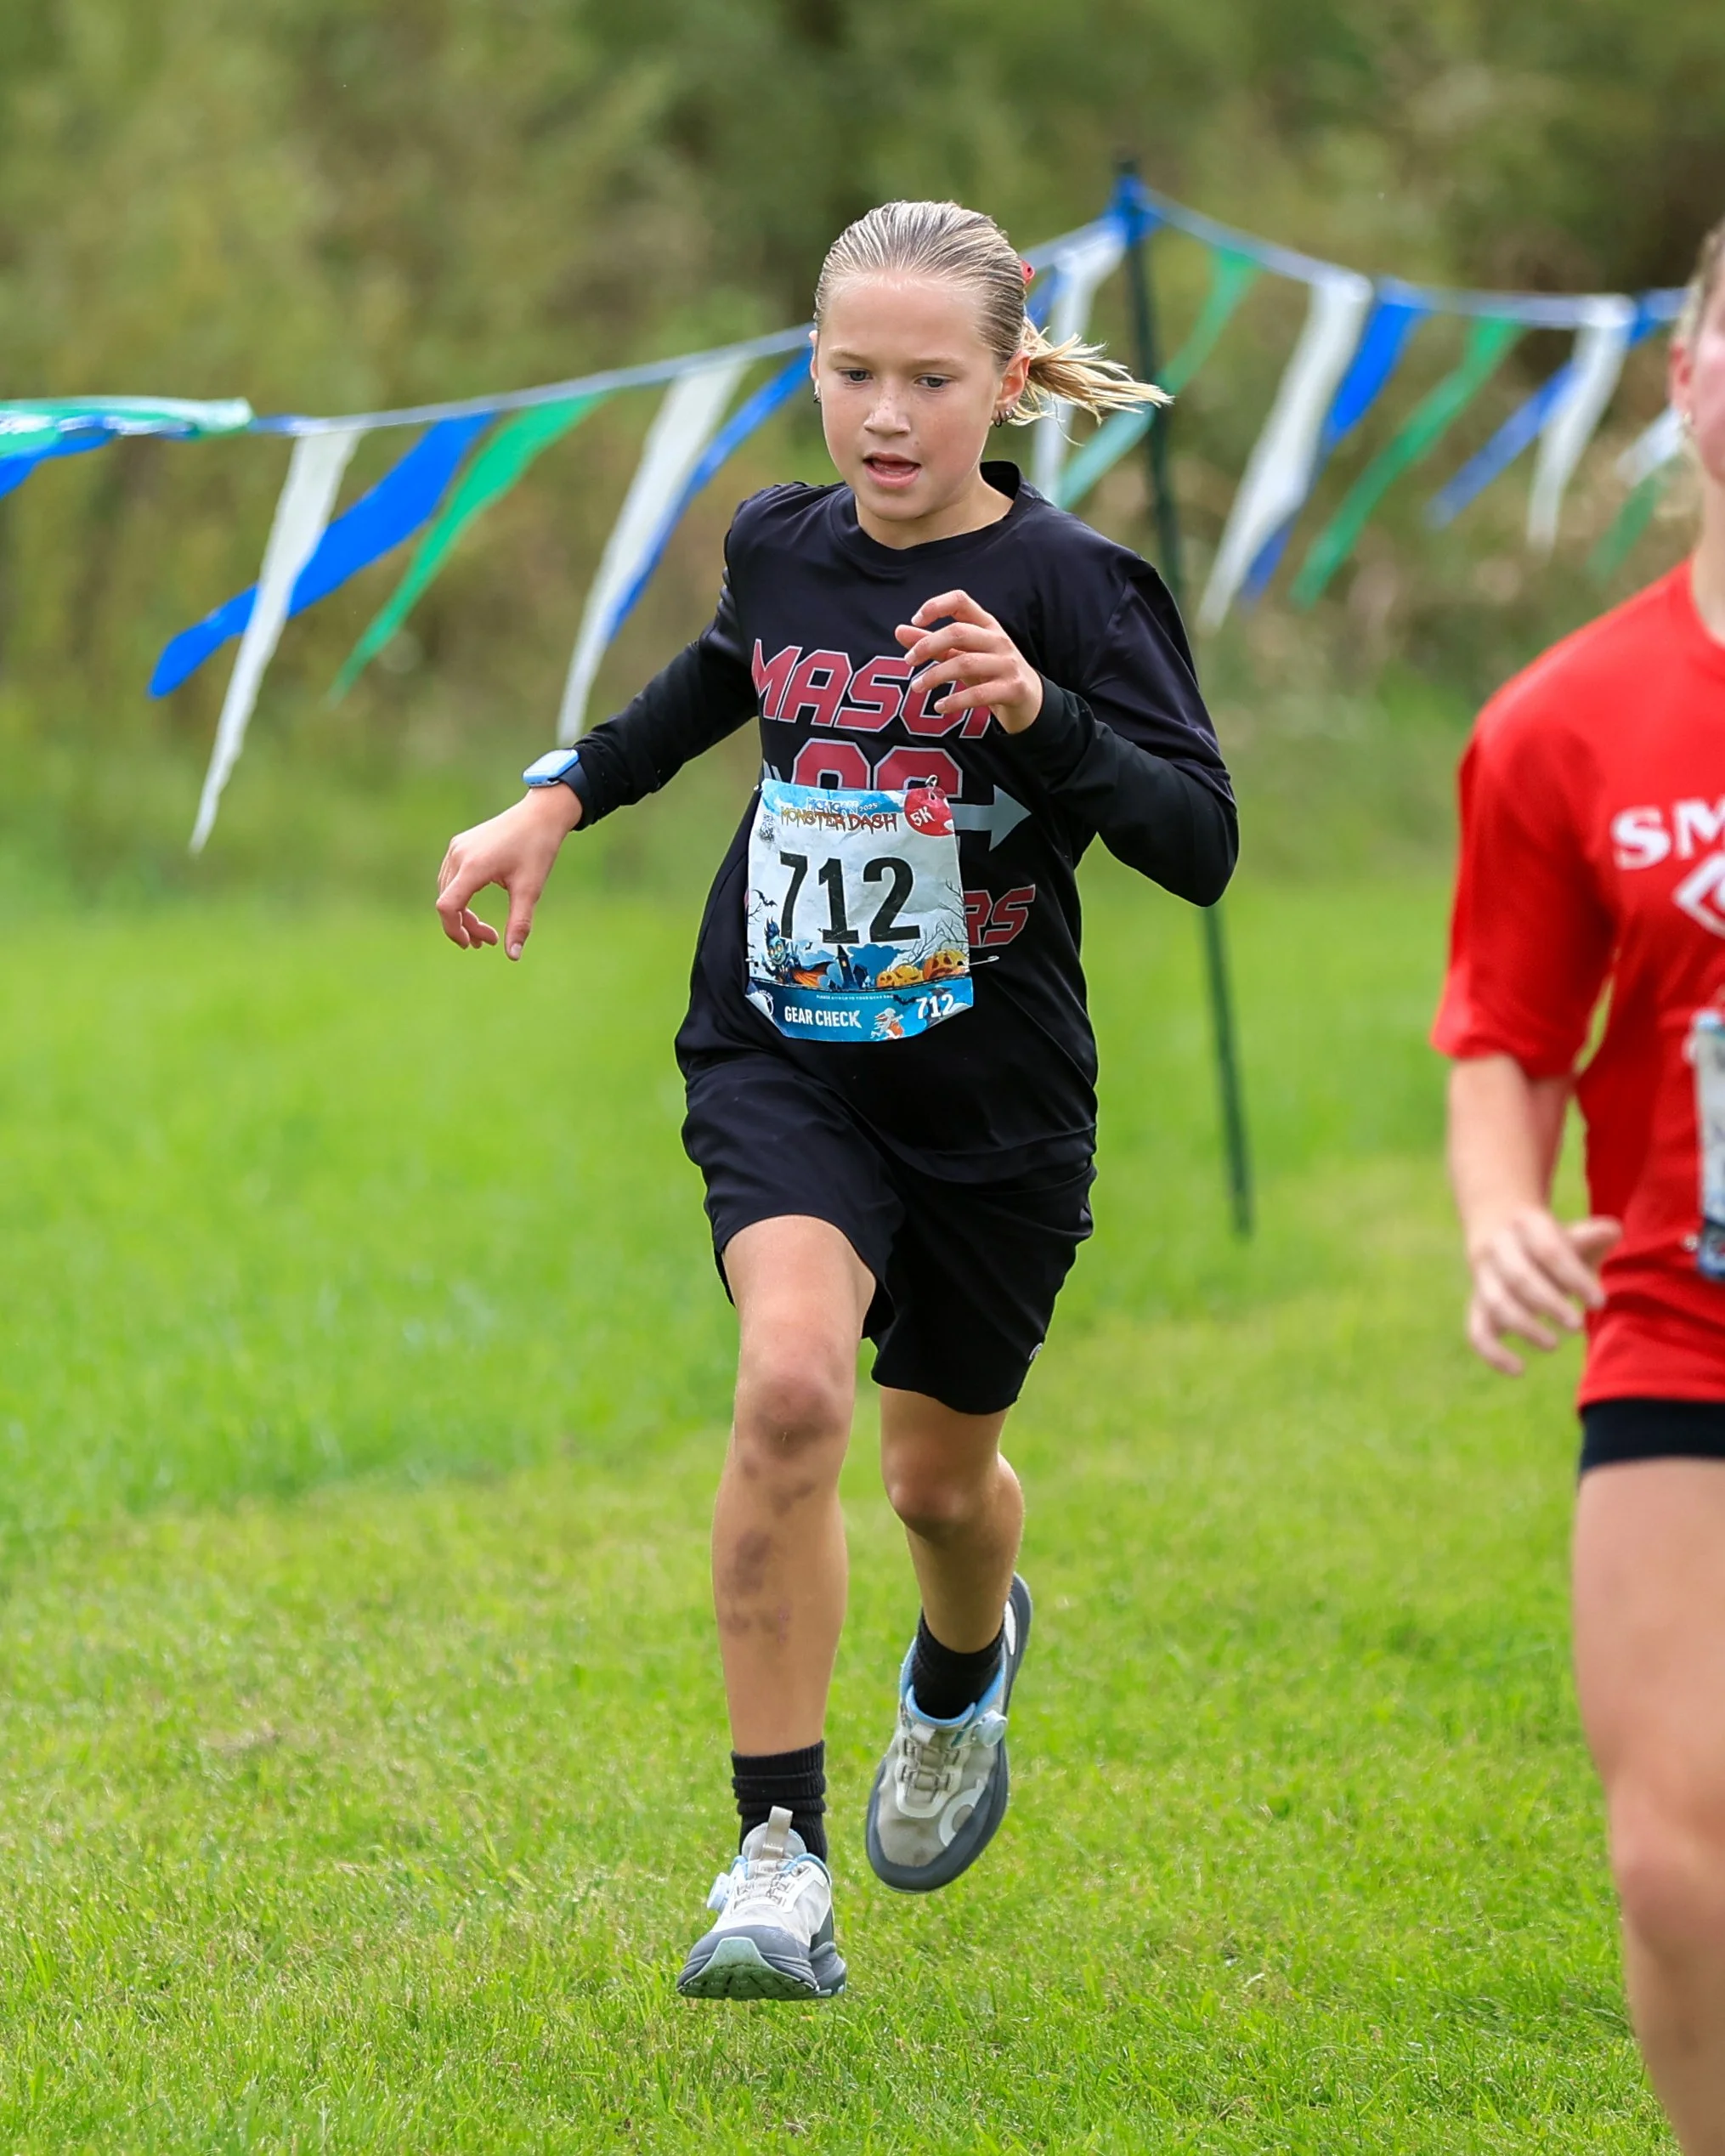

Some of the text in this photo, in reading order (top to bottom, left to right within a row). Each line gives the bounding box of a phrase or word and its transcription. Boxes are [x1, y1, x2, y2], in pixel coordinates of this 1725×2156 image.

[859, 802, 878, 813] 2025
[909, 806, 936, 827] 5K
[780, 806, 898, 835] MONSTER DASH
[779, 850, 921, 944] 712
[784, 1005, 862, 1029] GEAR CHECK
[916, 993, 954, 1020] 712
